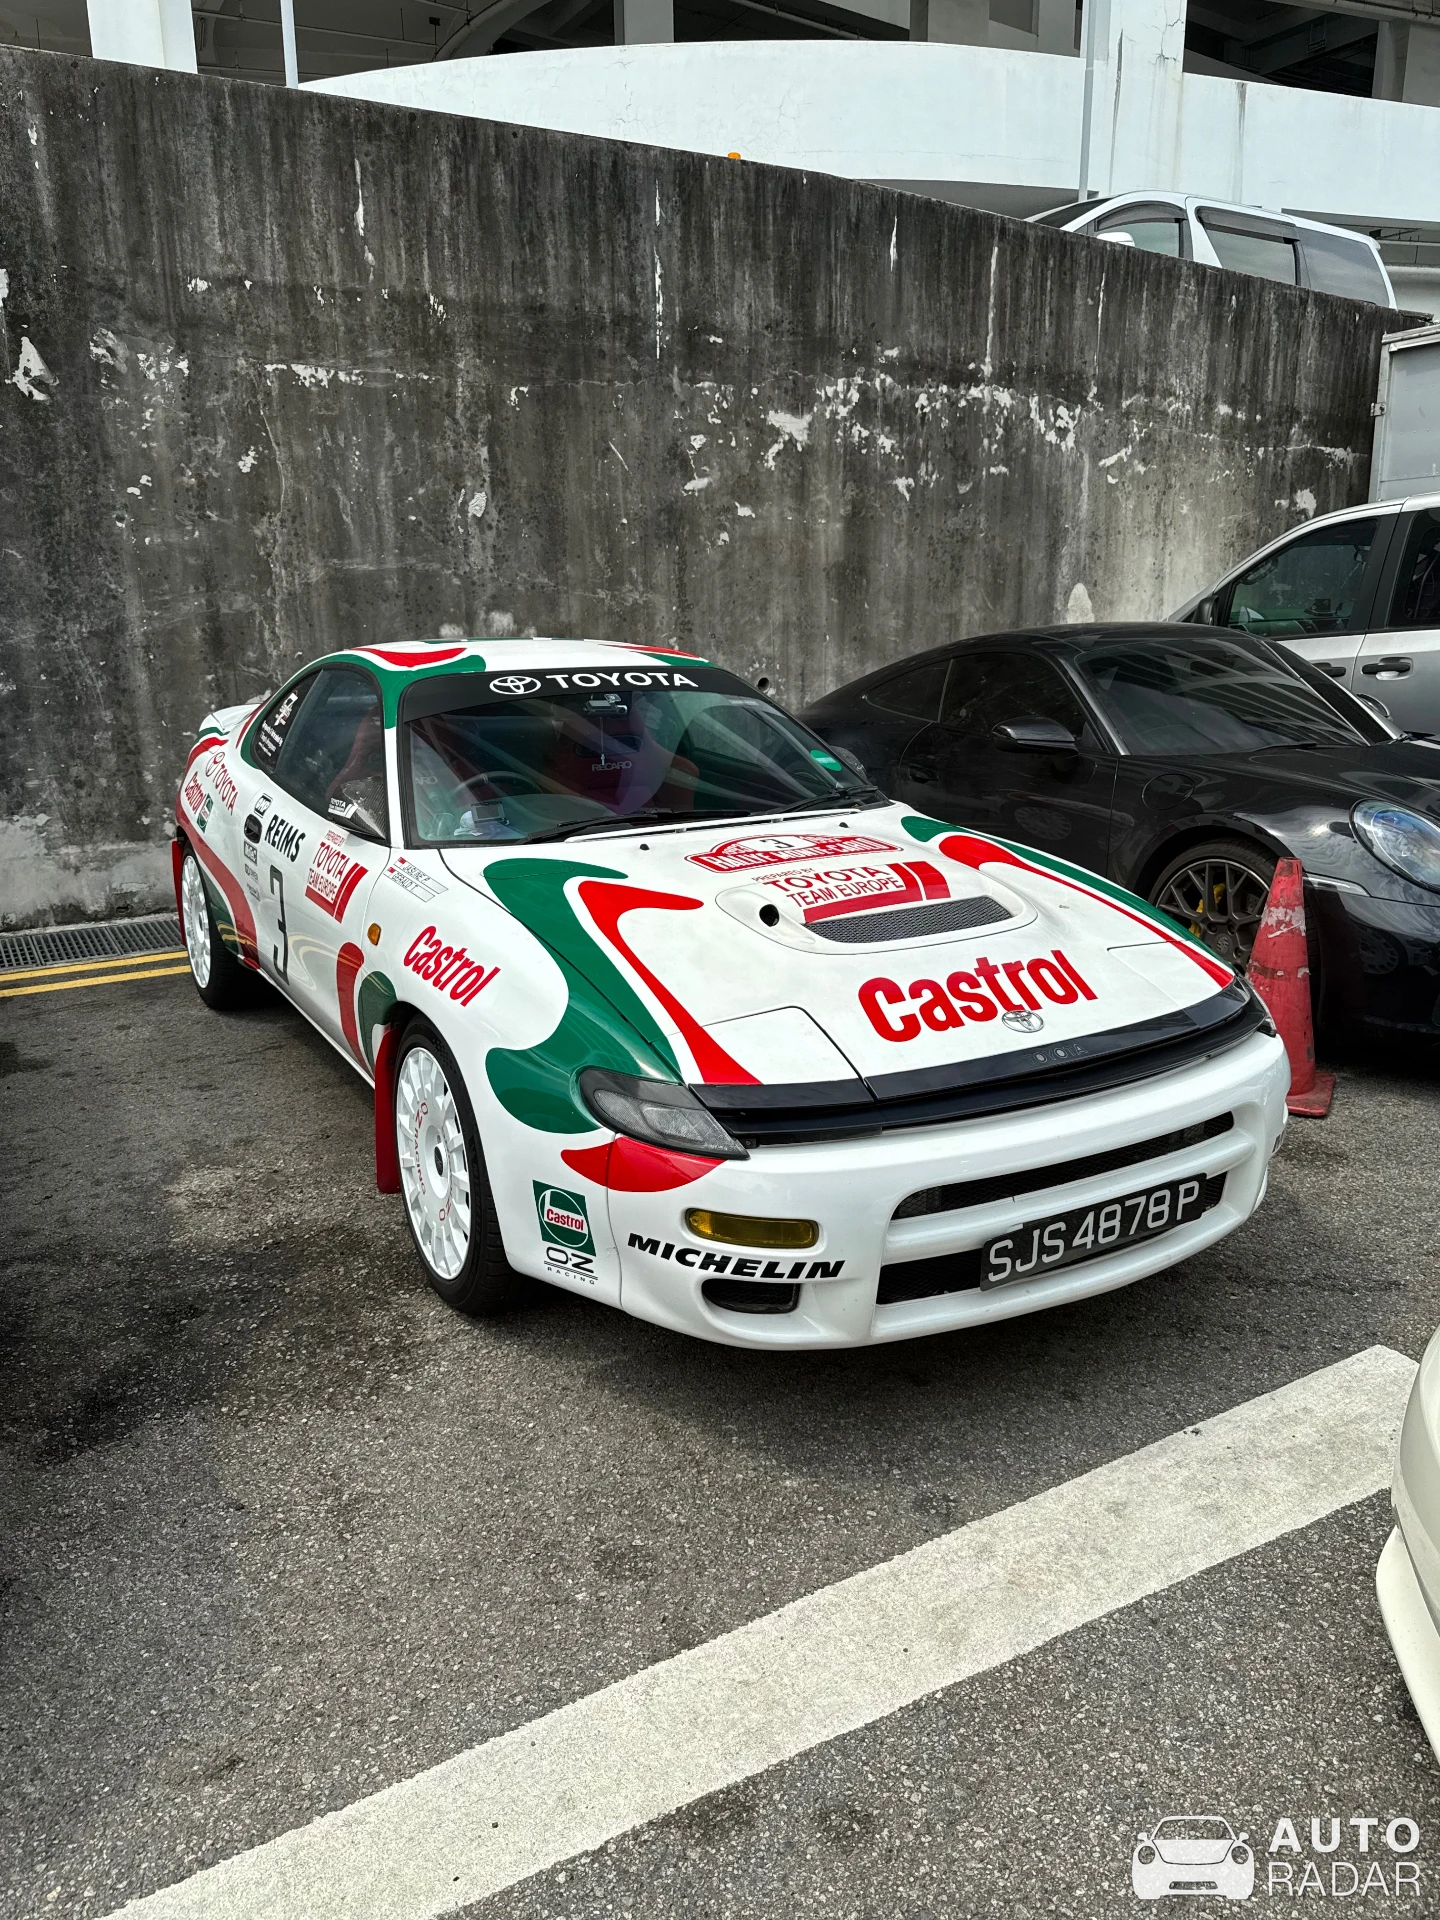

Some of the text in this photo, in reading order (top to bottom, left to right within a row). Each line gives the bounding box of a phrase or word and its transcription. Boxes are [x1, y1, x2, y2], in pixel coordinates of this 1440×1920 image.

[545, 671, 699, 689] TOYOTA
[591, 760, 632, 772] RECARO
[264, 814, 306, 863] REIMS
[759, 838, 796, 849] 3
[312, 841, 350, 882] TOYOTA
[704, 850, 778, 870] RALLYE
[751, 867, 817, 882] PREPARED BY
[762, 863, 885, 893] TOYOTA
[786, 877, 906, 908] TEAM EUROPE
[269, 864, 290, 986] 3
[403, 925, 501, 1008] Castrol
[858, 950, 1098, 1042] Castrol
[1022, 1043, 1088, 1065] TOYOTA
[546, 1208, 584, 1231] Castrol
[627, 1232, 846, 1279] MICHELIN
[547, 1267, 595, 1286] RACING
